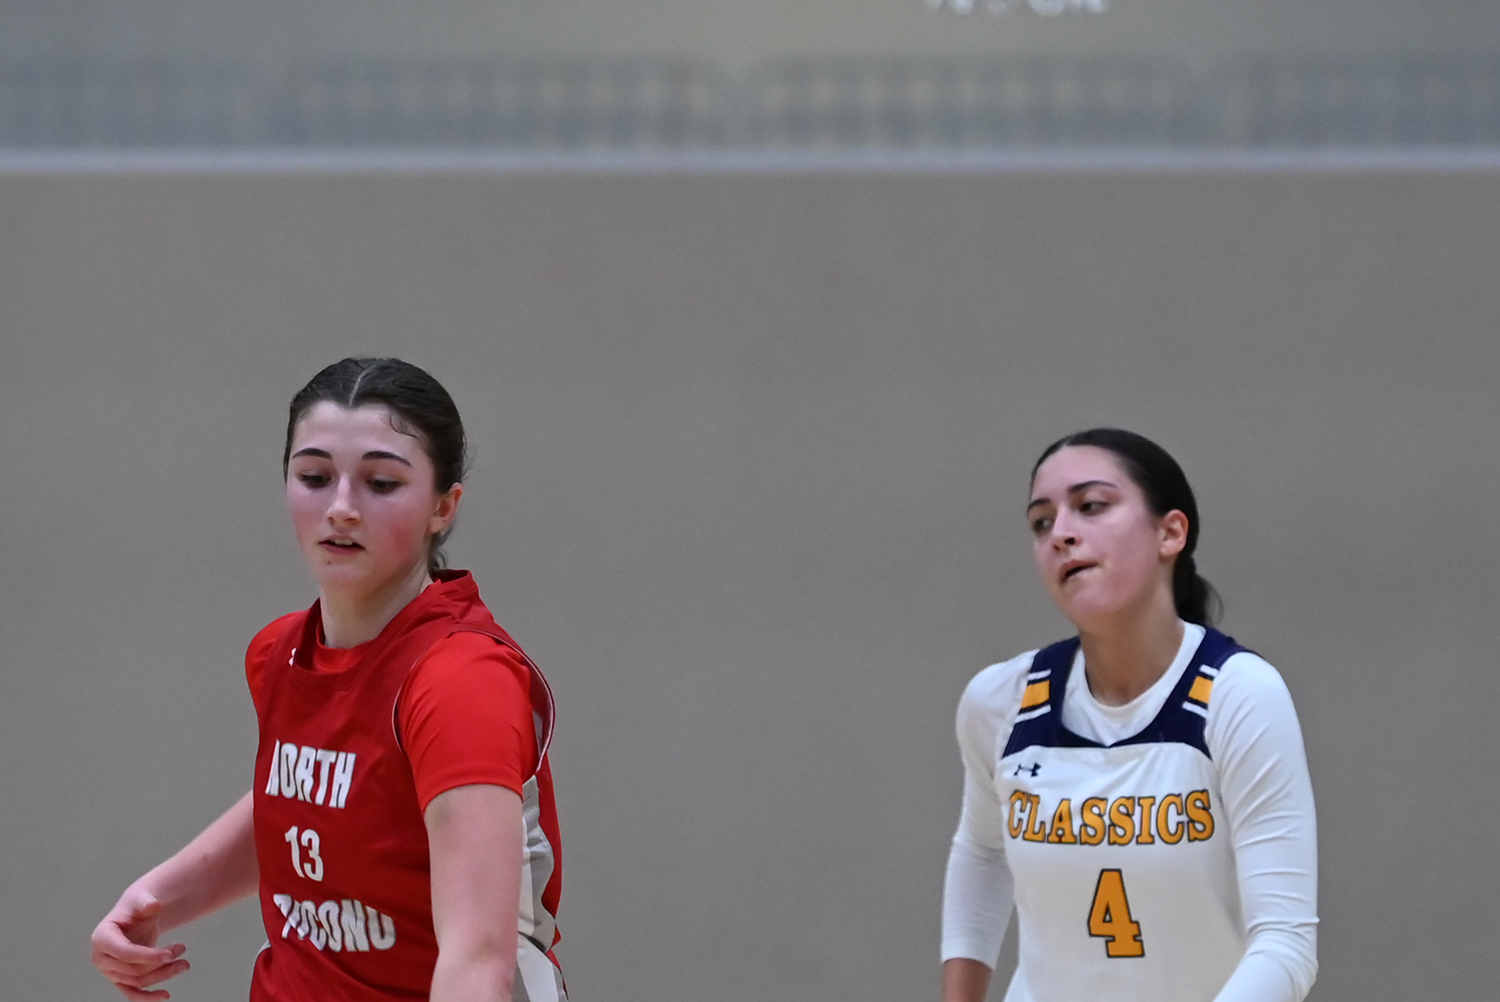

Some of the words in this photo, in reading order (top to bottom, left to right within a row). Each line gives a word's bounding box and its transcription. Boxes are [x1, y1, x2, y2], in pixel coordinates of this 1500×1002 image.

[1007, 788, 1215, 846] CLASSICS
[285, 825, 325, 882] 13
[1087, 868, 1145, 958] 4
